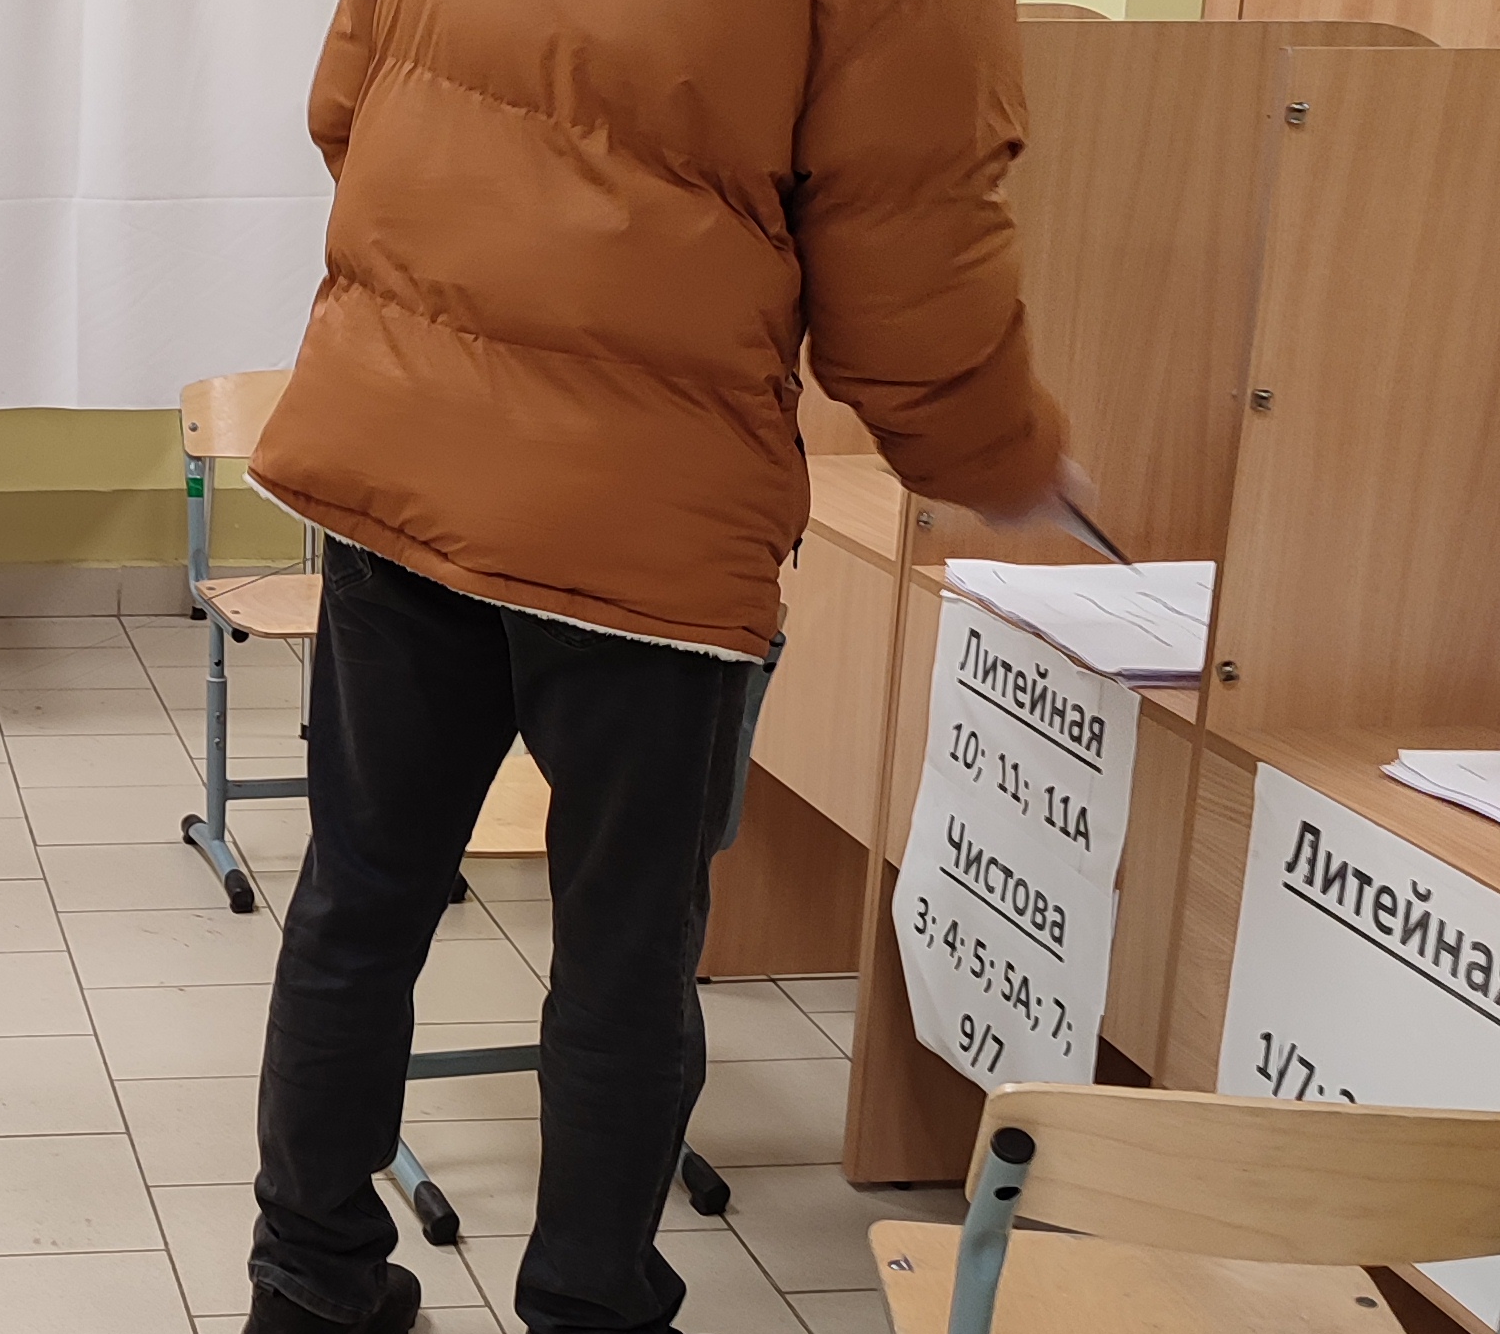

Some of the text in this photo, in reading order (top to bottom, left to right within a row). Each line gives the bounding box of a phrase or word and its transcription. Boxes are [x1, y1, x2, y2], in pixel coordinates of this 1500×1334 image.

[958, 627, 1106, 759] Литейная
[949, 723, 1091, 852] 10; 11; 11А
[947, 814, 1066, 948] Чистова
[1284, 820, 1500, 1005] Литейна
[913, 896, 1073, 1057] 3; 4; 5; 5А; 7;
[958, 1013, 1005, 1074] 9/7
